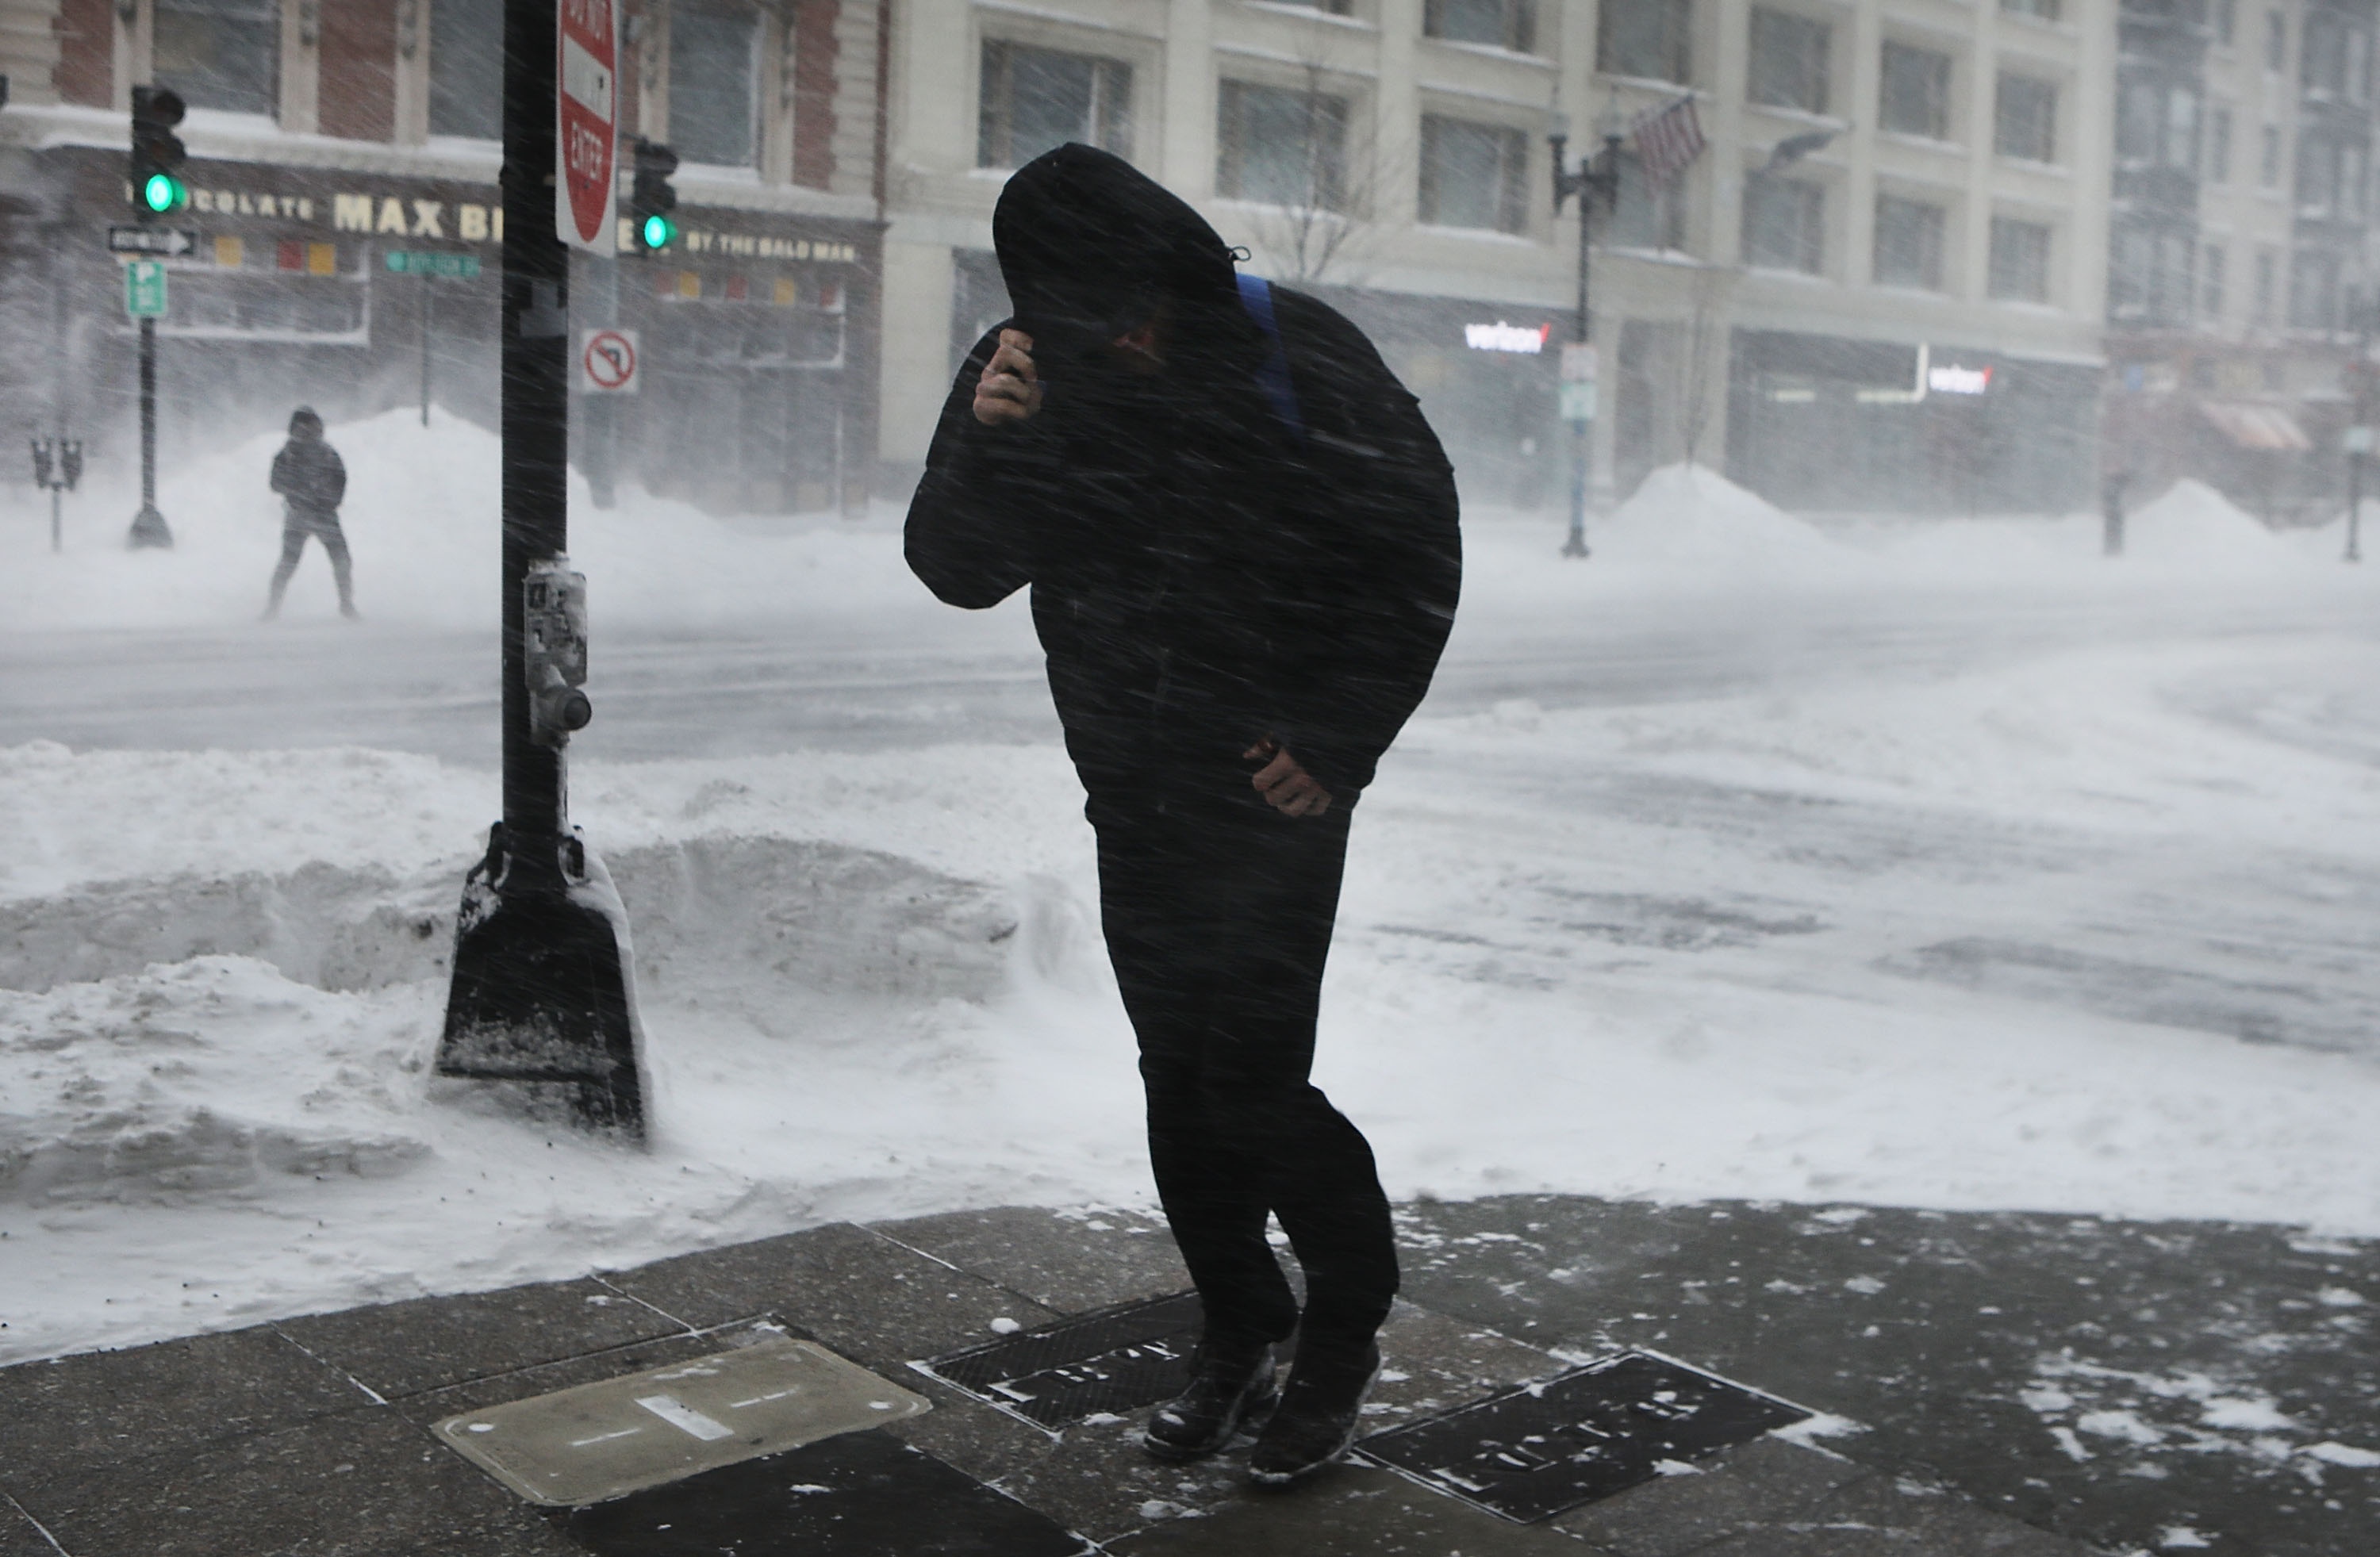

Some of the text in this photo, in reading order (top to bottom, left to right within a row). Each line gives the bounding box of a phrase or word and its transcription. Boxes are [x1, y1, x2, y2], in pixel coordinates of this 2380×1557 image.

[125, 182, 313, 221] COLATE
[334, 194, 443, 238] MAX
[686, 230, 712, 253] BY
